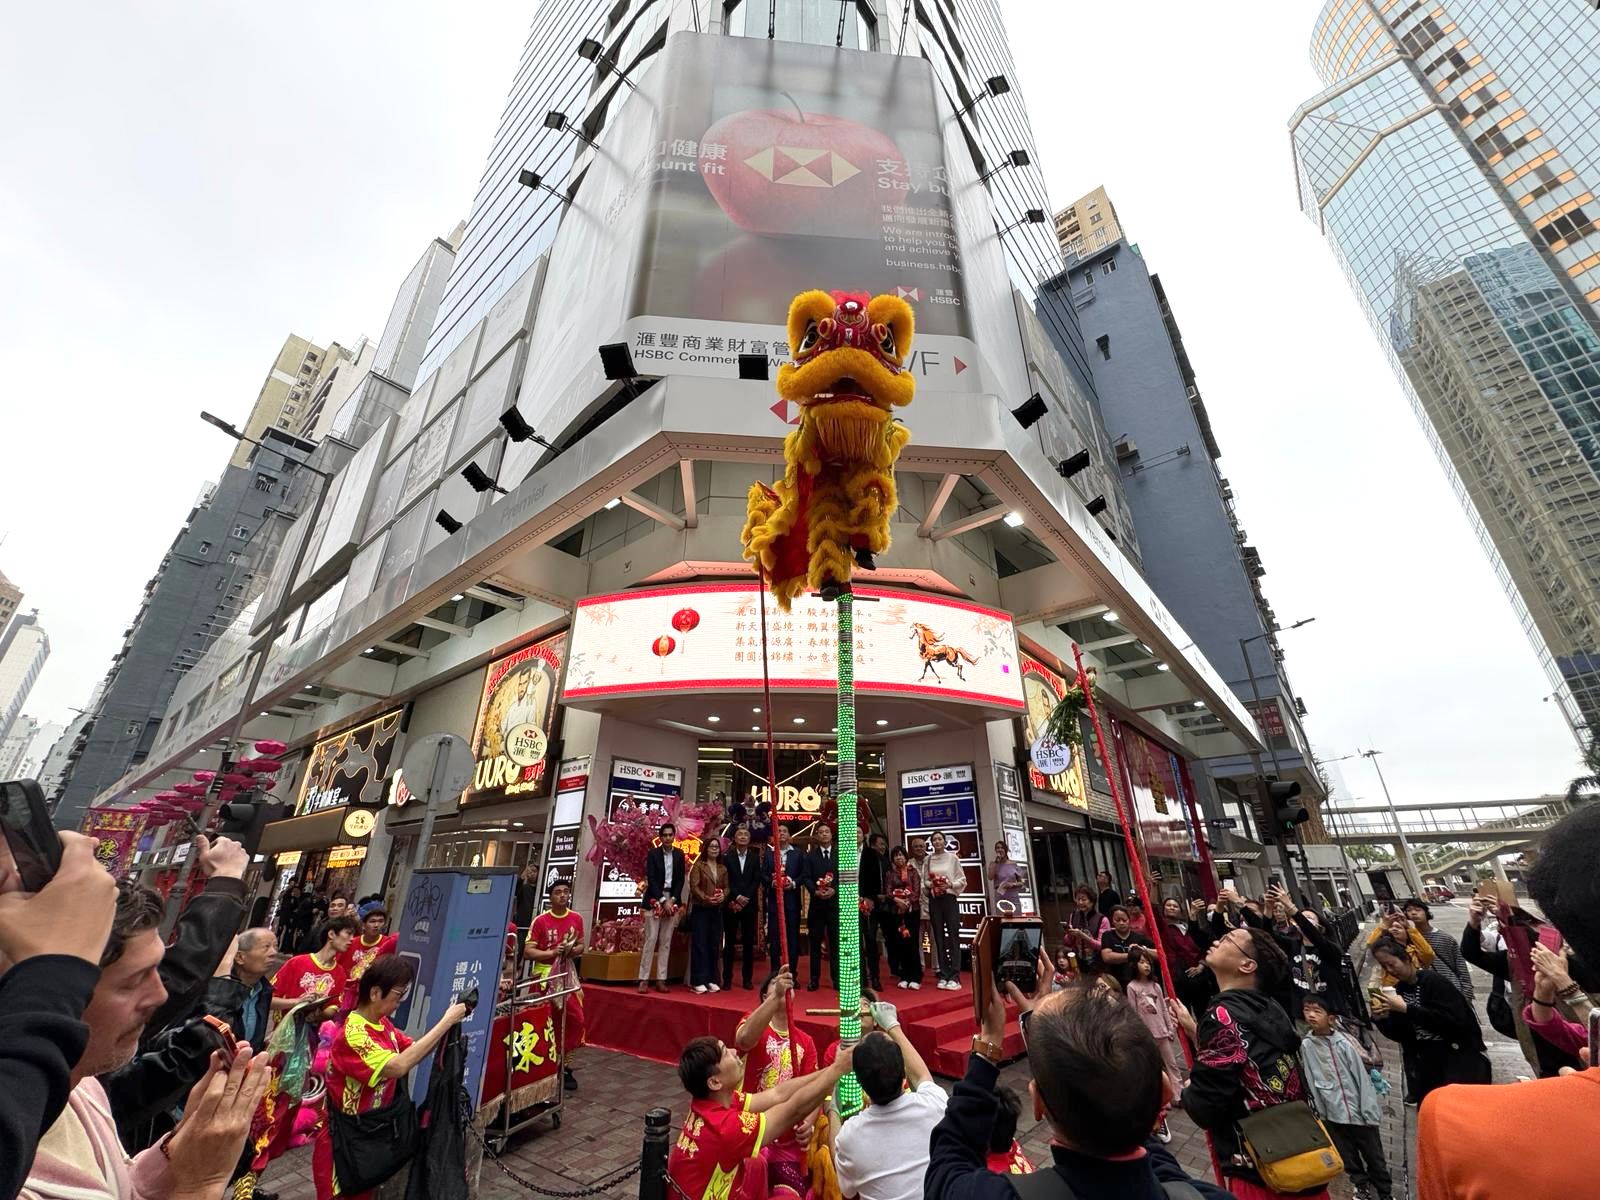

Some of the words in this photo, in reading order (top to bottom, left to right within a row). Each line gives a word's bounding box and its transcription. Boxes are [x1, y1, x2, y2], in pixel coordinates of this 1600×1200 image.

[702, 162, 727, 176] fit
[877, 177, 921, 194] Stay
[882, 225, 901, 235] We
[883, 235, 895, 243] to
[898, 235, 922, 246] help
[884, 244, 906, 252] and
[908, 246, 951, 257] achieve
[929, 295, 961, 306] HSBC
[634, 349, 675, 361] HSBC
[901, 350, 940, 376] /F
[514, 736, 543, 751] HSBC
[1036, 750, 1064, 759] HSBC
[619, 764, 643, 777] HSBC
[907, 773, 930, 784] HSBC
